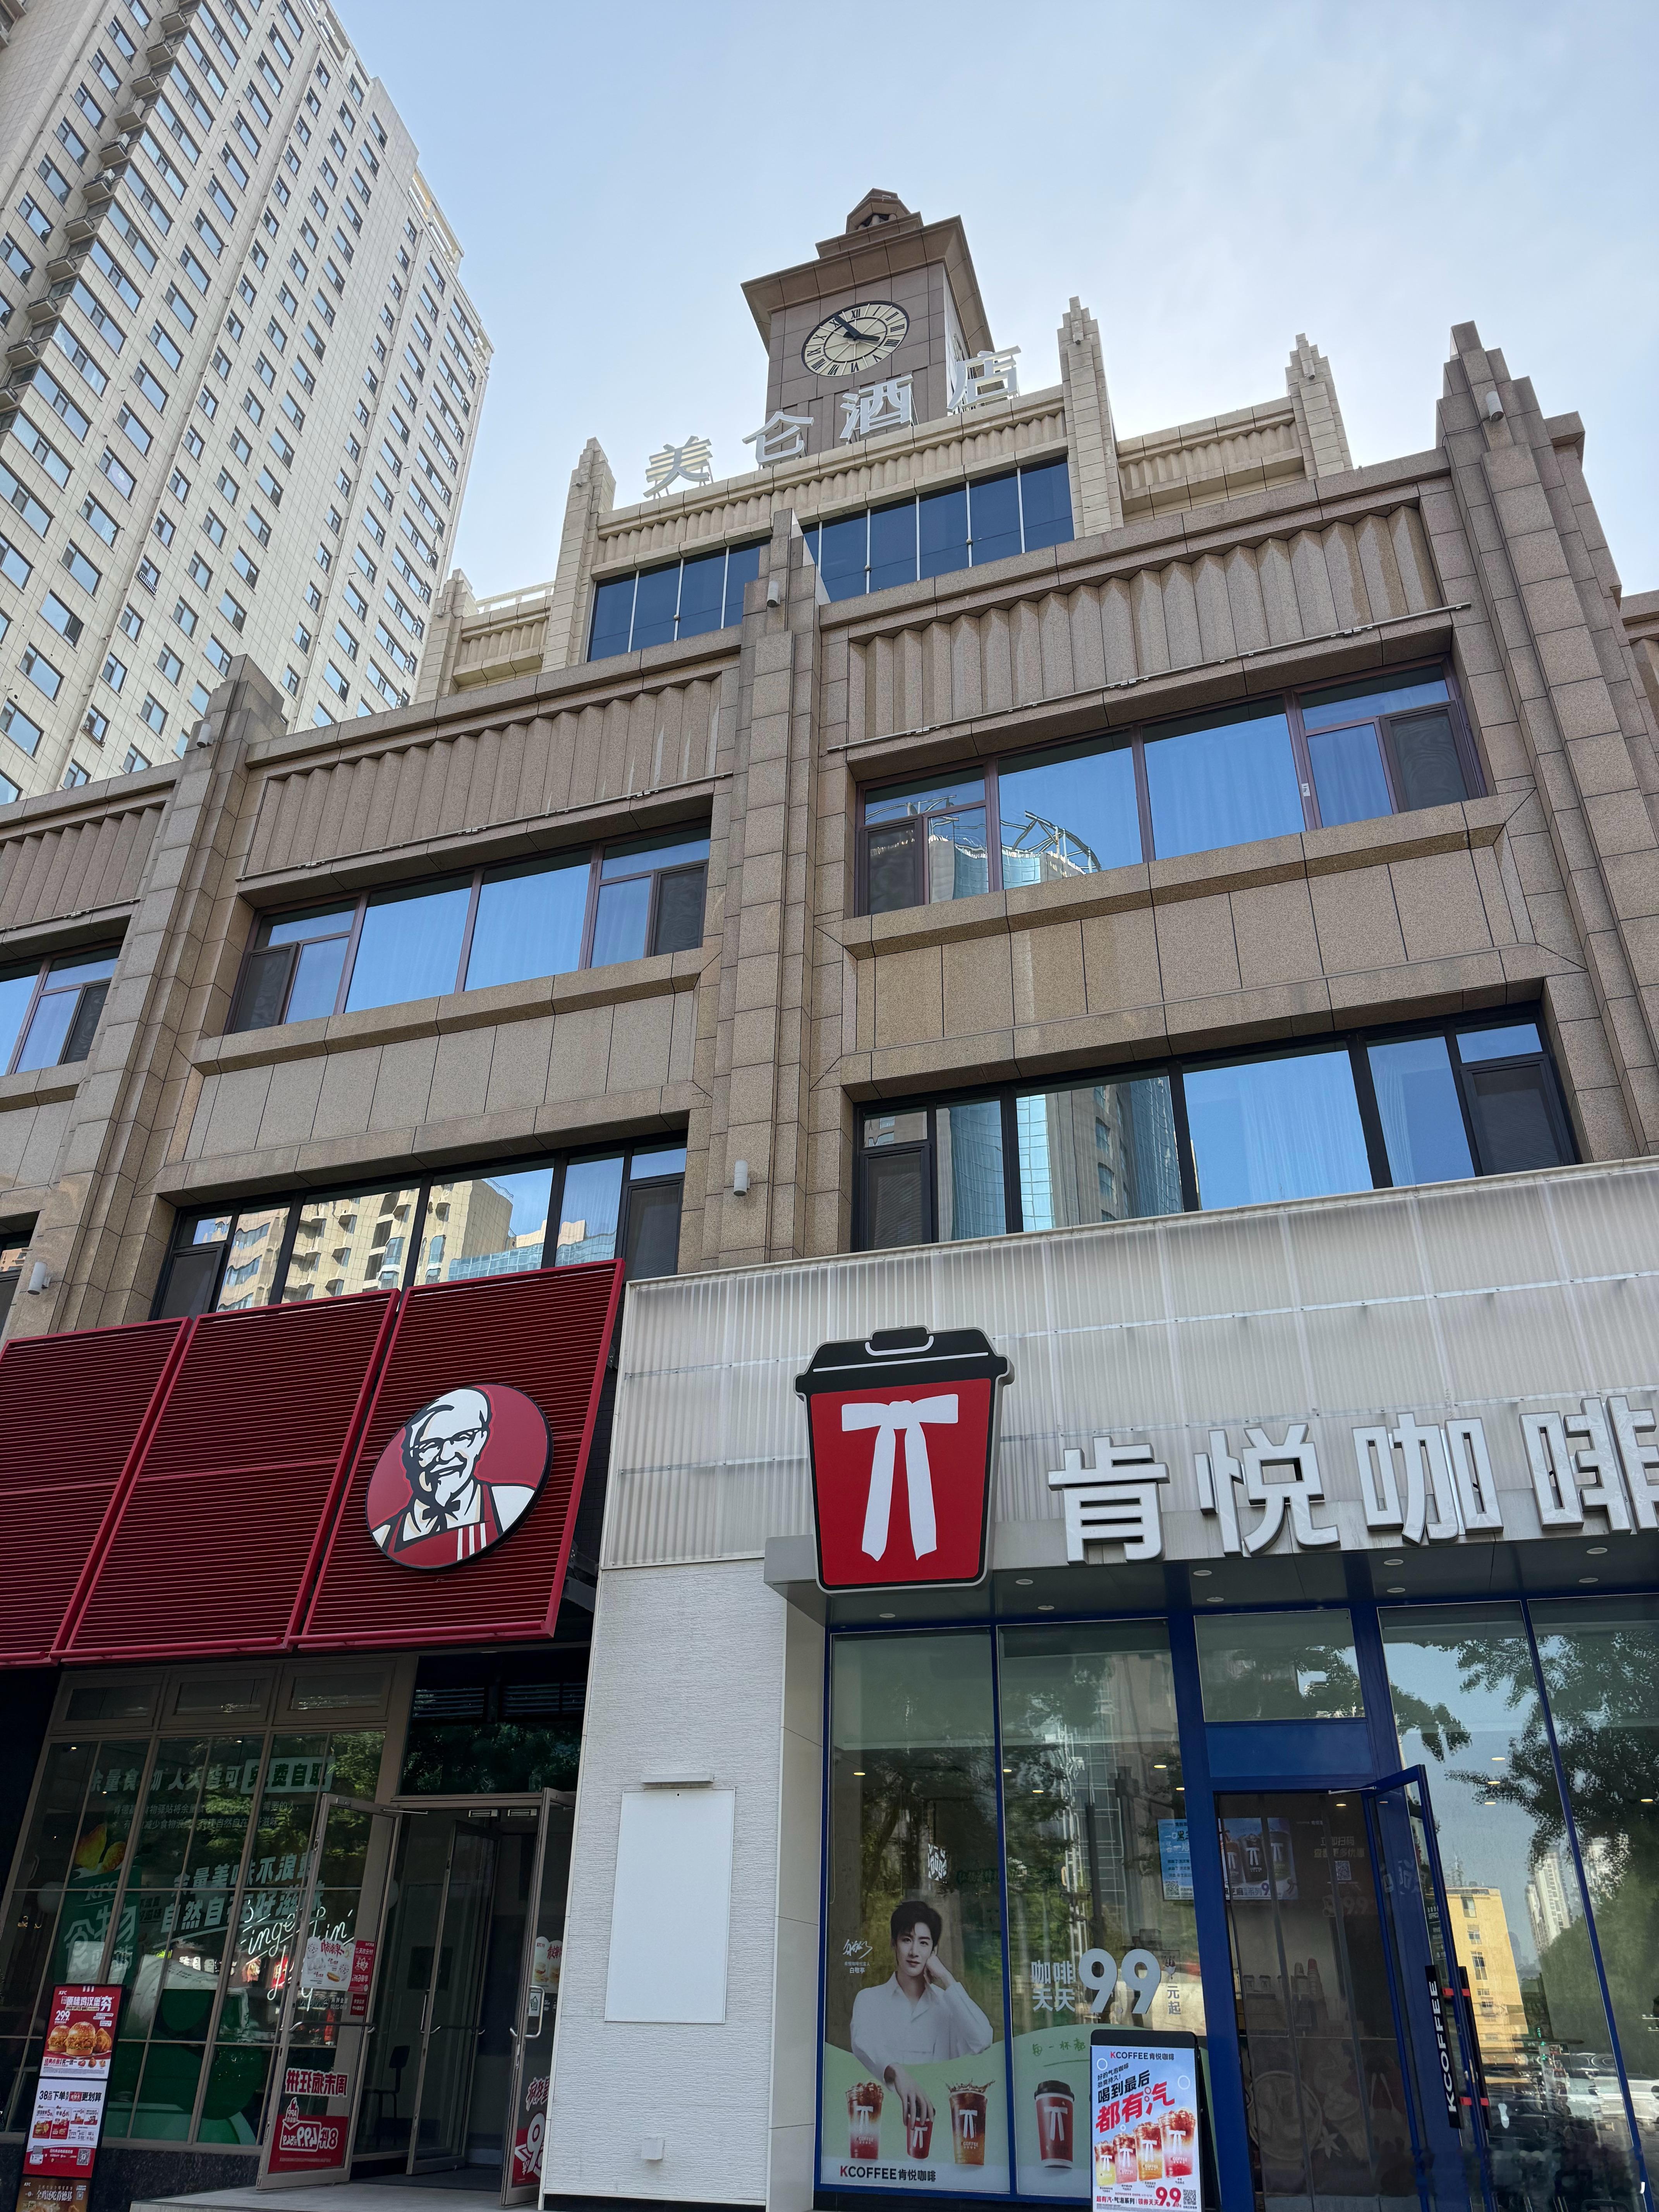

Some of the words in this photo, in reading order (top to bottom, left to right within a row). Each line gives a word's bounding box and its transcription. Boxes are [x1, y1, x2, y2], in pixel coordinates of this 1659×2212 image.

[850, 308, 860, 318] XII
[1031, 1960, 1076, 1984] 咖啡
[1032, 1988, 1075, 2012] 天天
[1111, 2051, 1148, 2059] KCOFFEE
[1429, 1980, 1457, 2112] KCOFFEE
[1097, 2063, 1129, 2081] 好的气泡咖啡
[1098, 2070, 1150, 2104] 喝到最后
[1095, 2081, 1175, 2133] 都有汽
[840, 2166, 897, 2180] KCOFFEE
[898, 2169, 936, 2182] 肯悦咖啡
[1156, 2187, 1181, 2207] 9.9
